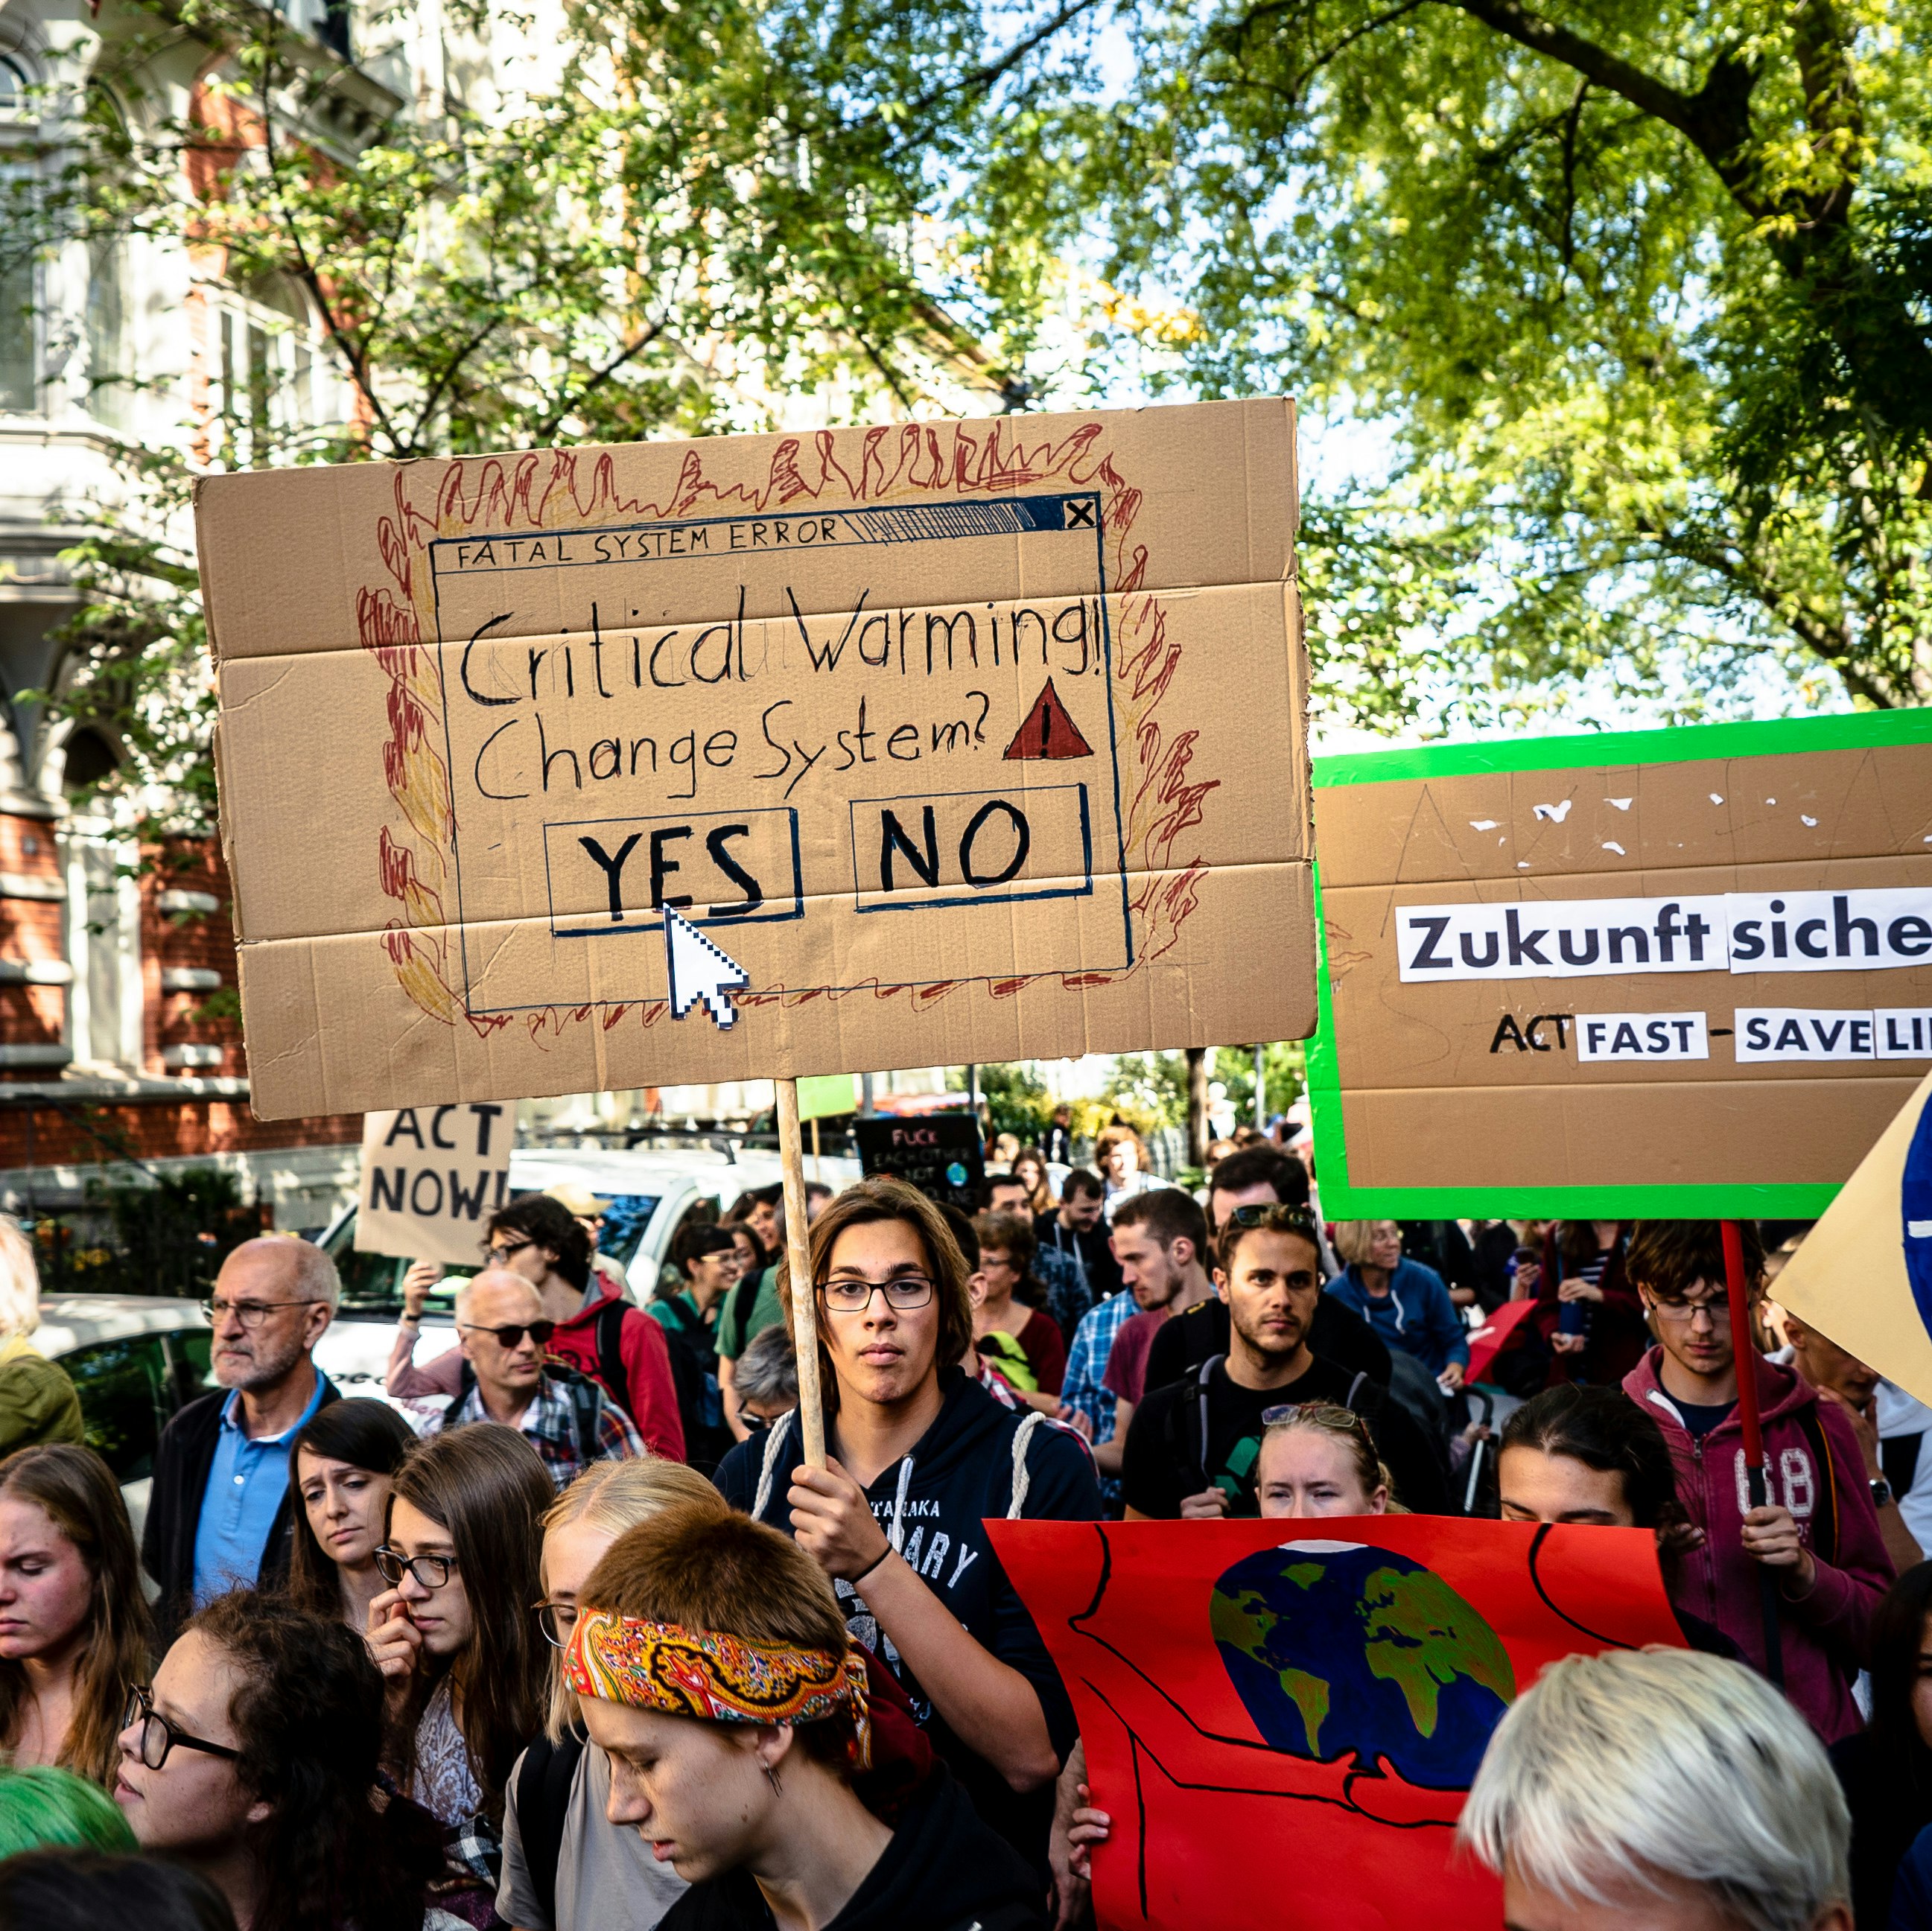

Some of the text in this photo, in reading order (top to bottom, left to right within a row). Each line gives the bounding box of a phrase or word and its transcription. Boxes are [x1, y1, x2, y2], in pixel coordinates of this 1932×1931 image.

[458, 518, 837, 569] FATAL SYSTEM ERROR
[460, 585, 1101, 706] Critical Warming!
[474, 690, 990, 799] Change System?
[578, 824, 765, 922] YES
[880, 799, 1031, 892] NO
[1408, 902, 1712, 969] Zukunft
[1489, 1014, 1574, 1054] ACT
[1586, 1019, 1695, 1054] FAST
[1746, 1017, 1872, 1053] SAVE
[1886, 1017, 1932, 1051] LI
[384, 1104, 503, 1156] ACT
[892, 1128, 938, 1147] FUCK
